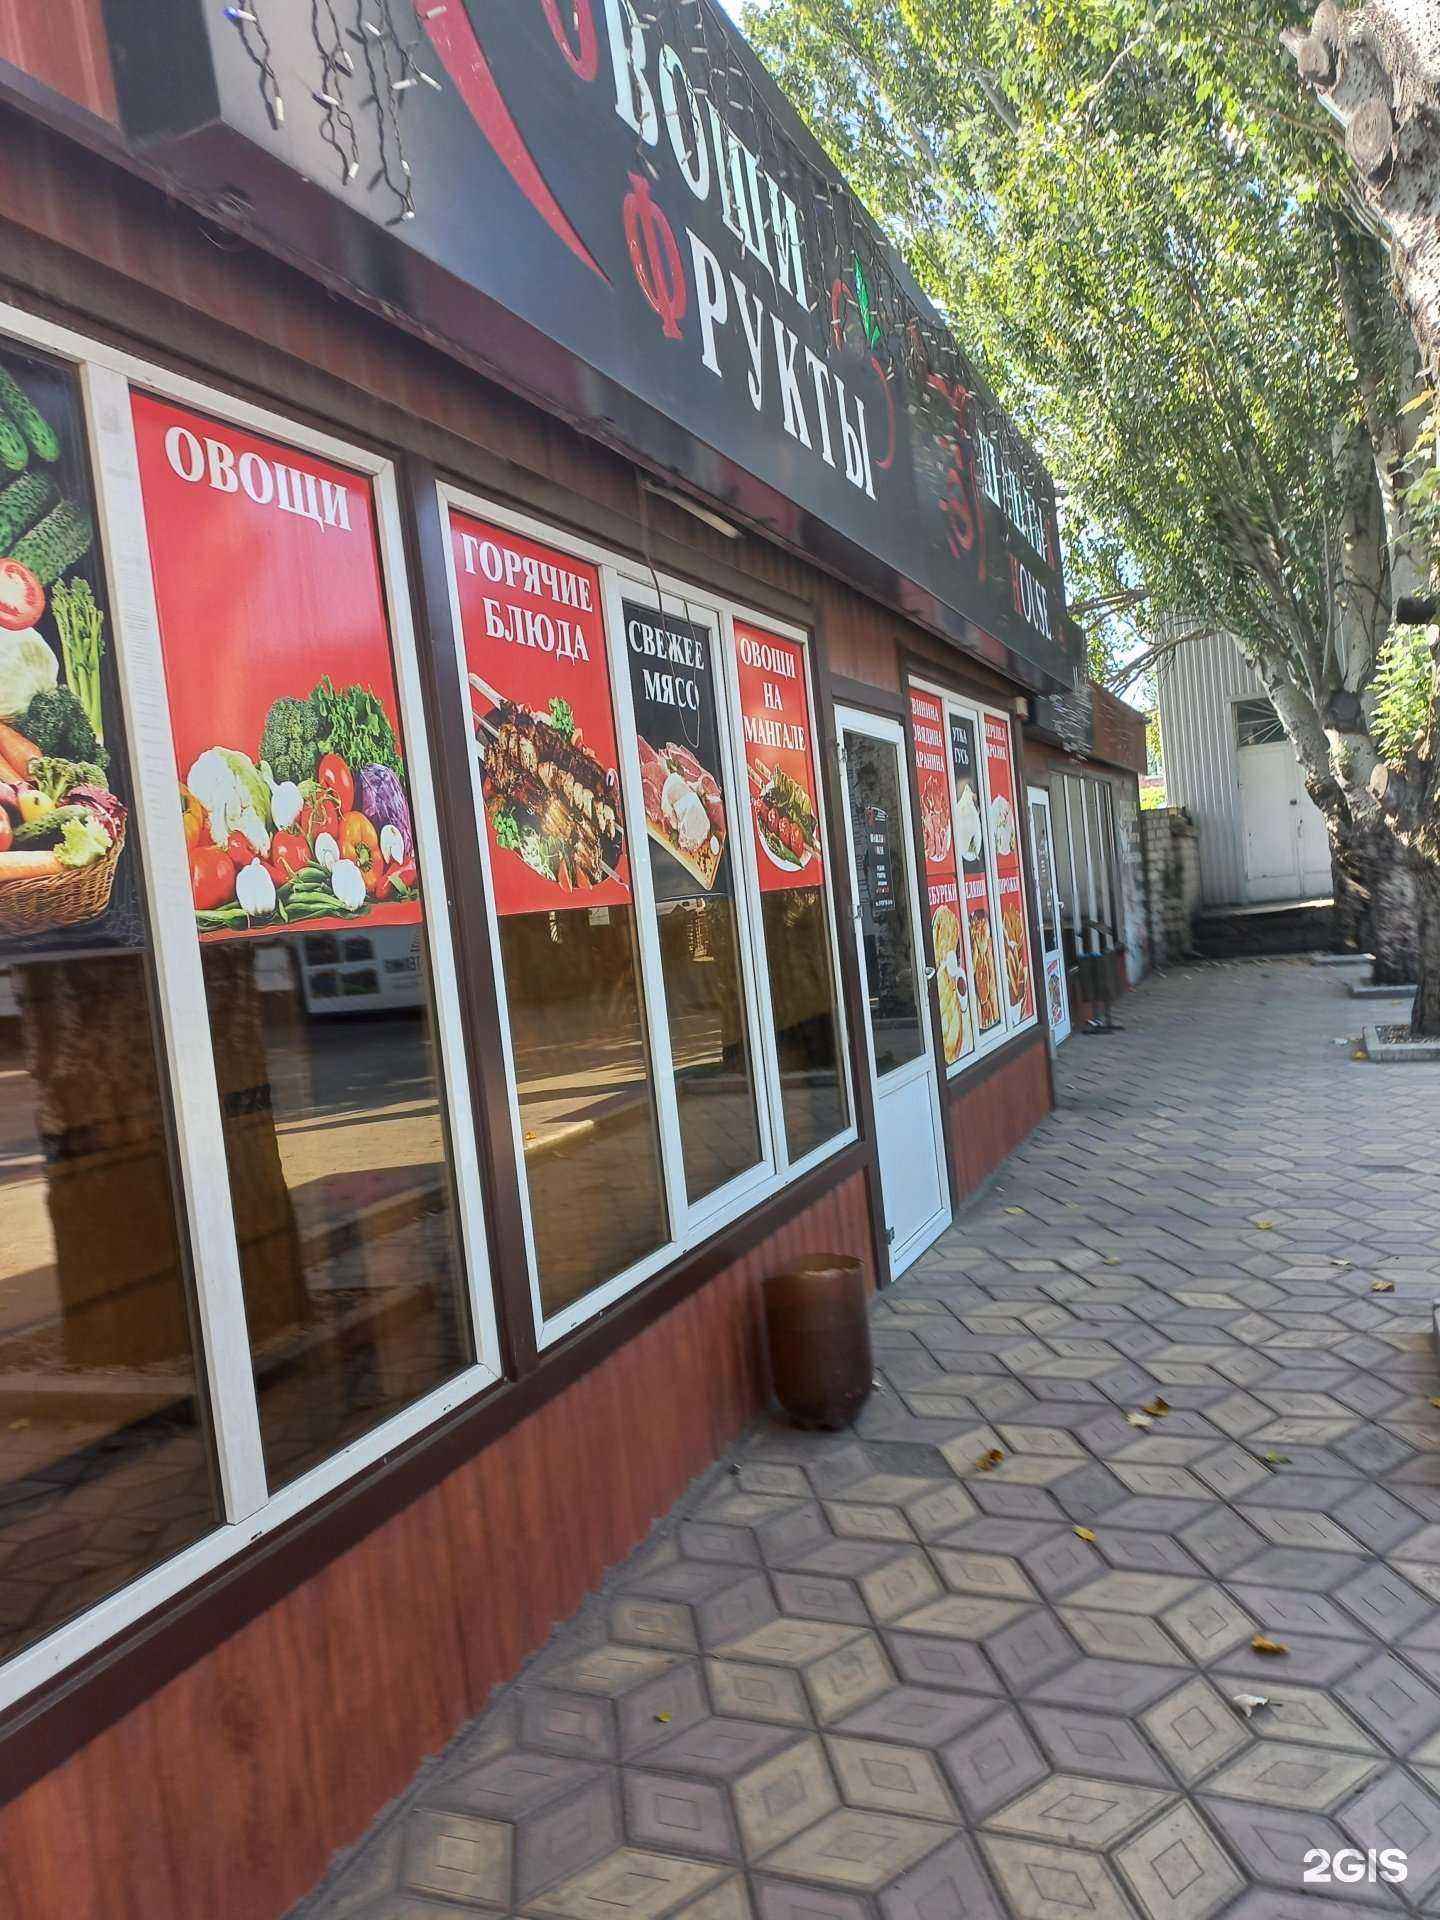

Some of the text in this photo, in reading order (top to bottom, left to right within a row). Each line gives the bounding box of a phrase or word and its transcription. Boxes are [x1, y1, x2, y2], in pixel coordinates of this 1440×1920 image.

[623, 170, 878, 502] ФРУКТЫ
[164, 426, 352, 533] ОВОЩИ
[460, 532, 593, 612] ГОРЯЧИЕ
[482, 598, 590, 665] БЛЮДА
[628, 620, 704, 670] СВЕЖЕЕ
[739, 637, 796, 680] ОВОЩИ
[642, 668, 700, 711] МЯСО
[762, 682, 783, 712] НА
[743, 715, 806, 752] МАНГАЛЕ
